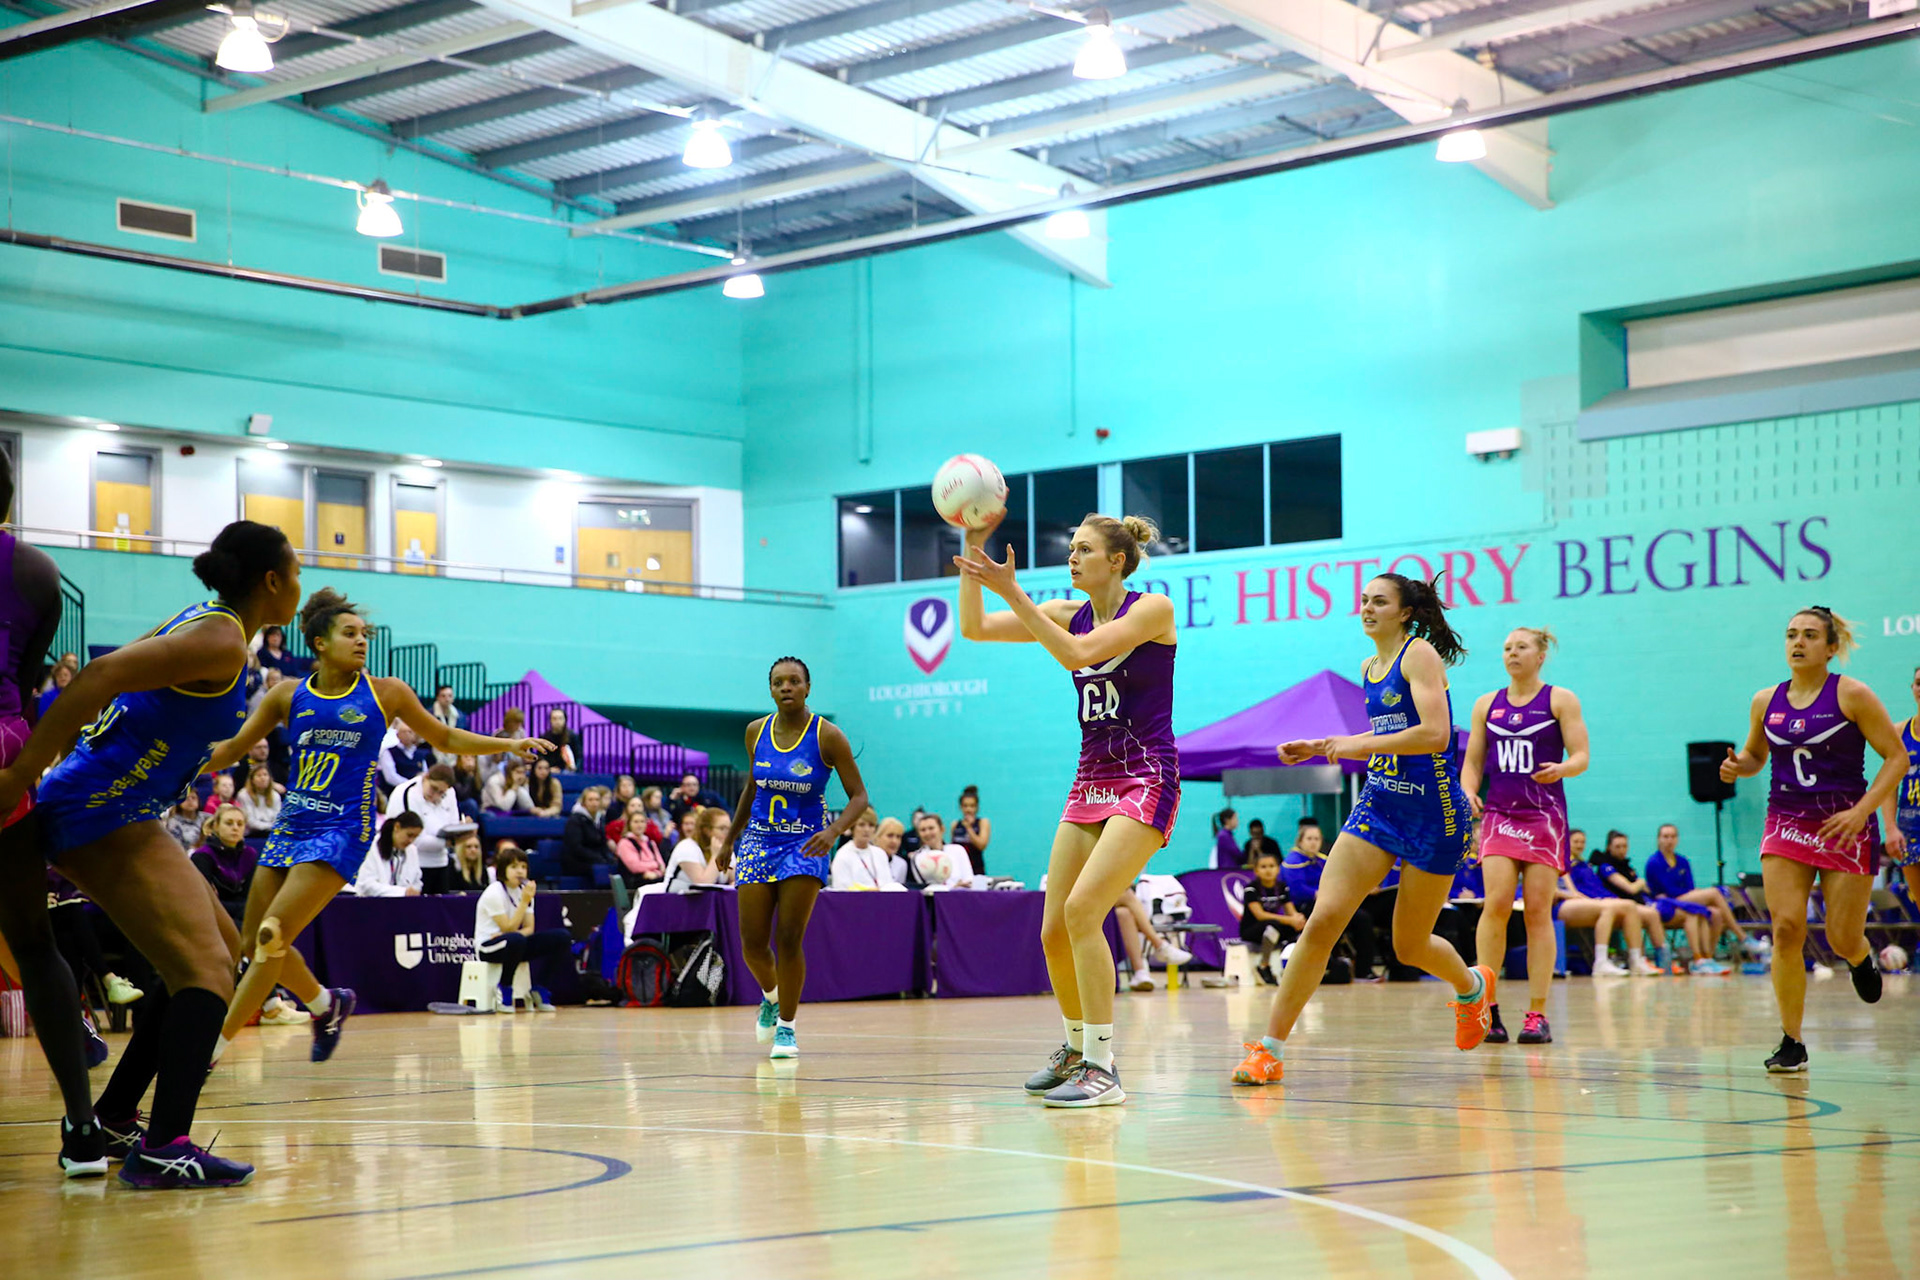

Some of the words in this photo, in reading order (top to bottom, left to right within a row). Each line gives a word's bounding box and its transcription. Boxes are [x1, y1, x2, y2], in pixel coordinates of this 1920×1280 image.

[1553, 516, 1832, 600] BEGINS
[1082, 680, 1120, 723] GA
[314, 729, 362, 742] SPORTING
[295, 749, 341, 792] WD
[1497, 739, 1535, 774] WD
[1793, 748, 1817, 787] C
[767, 779, 812, 793] SPORTING
[1084, 783, 1119, 805] Vitality
[1431, 752, 1458, 837] eAreTeamBath
[768, 794, 788, 825] C
[1780, 827, 1827, 852] Vitality
